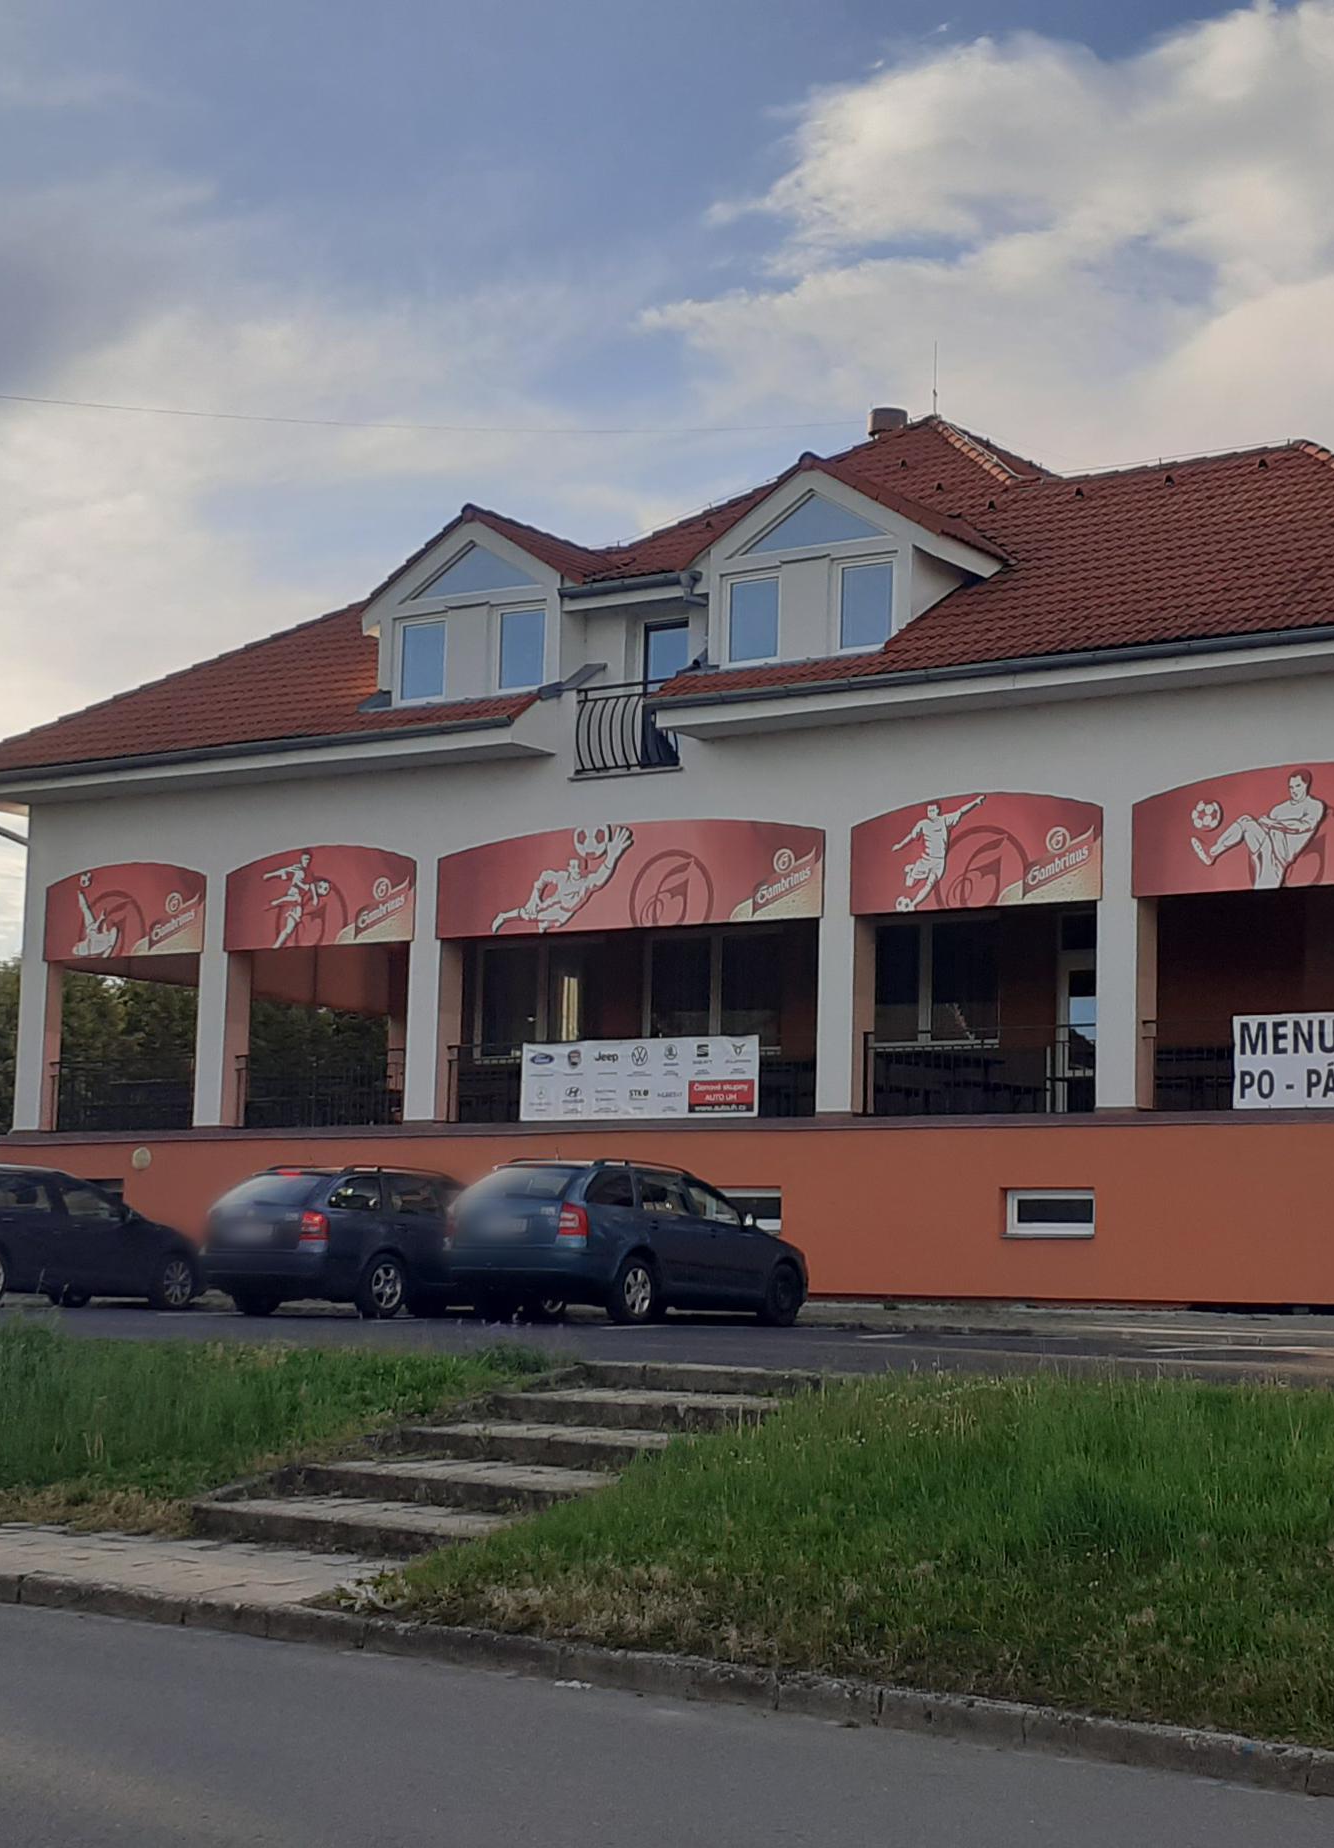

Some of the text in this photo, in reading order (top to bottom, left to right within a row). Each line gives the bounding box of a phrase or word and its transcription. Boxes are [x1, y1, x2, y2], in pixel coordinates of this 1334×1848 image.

[1025, 845, 1089, 885] Gambrinus
[755, 866, 812, 904] Gambrinus
[594, 1051, 619, 1063] Jeep
[705, 1093, 724, 1101] AUTO
[1239, 1070, 1275, 1099] PO
